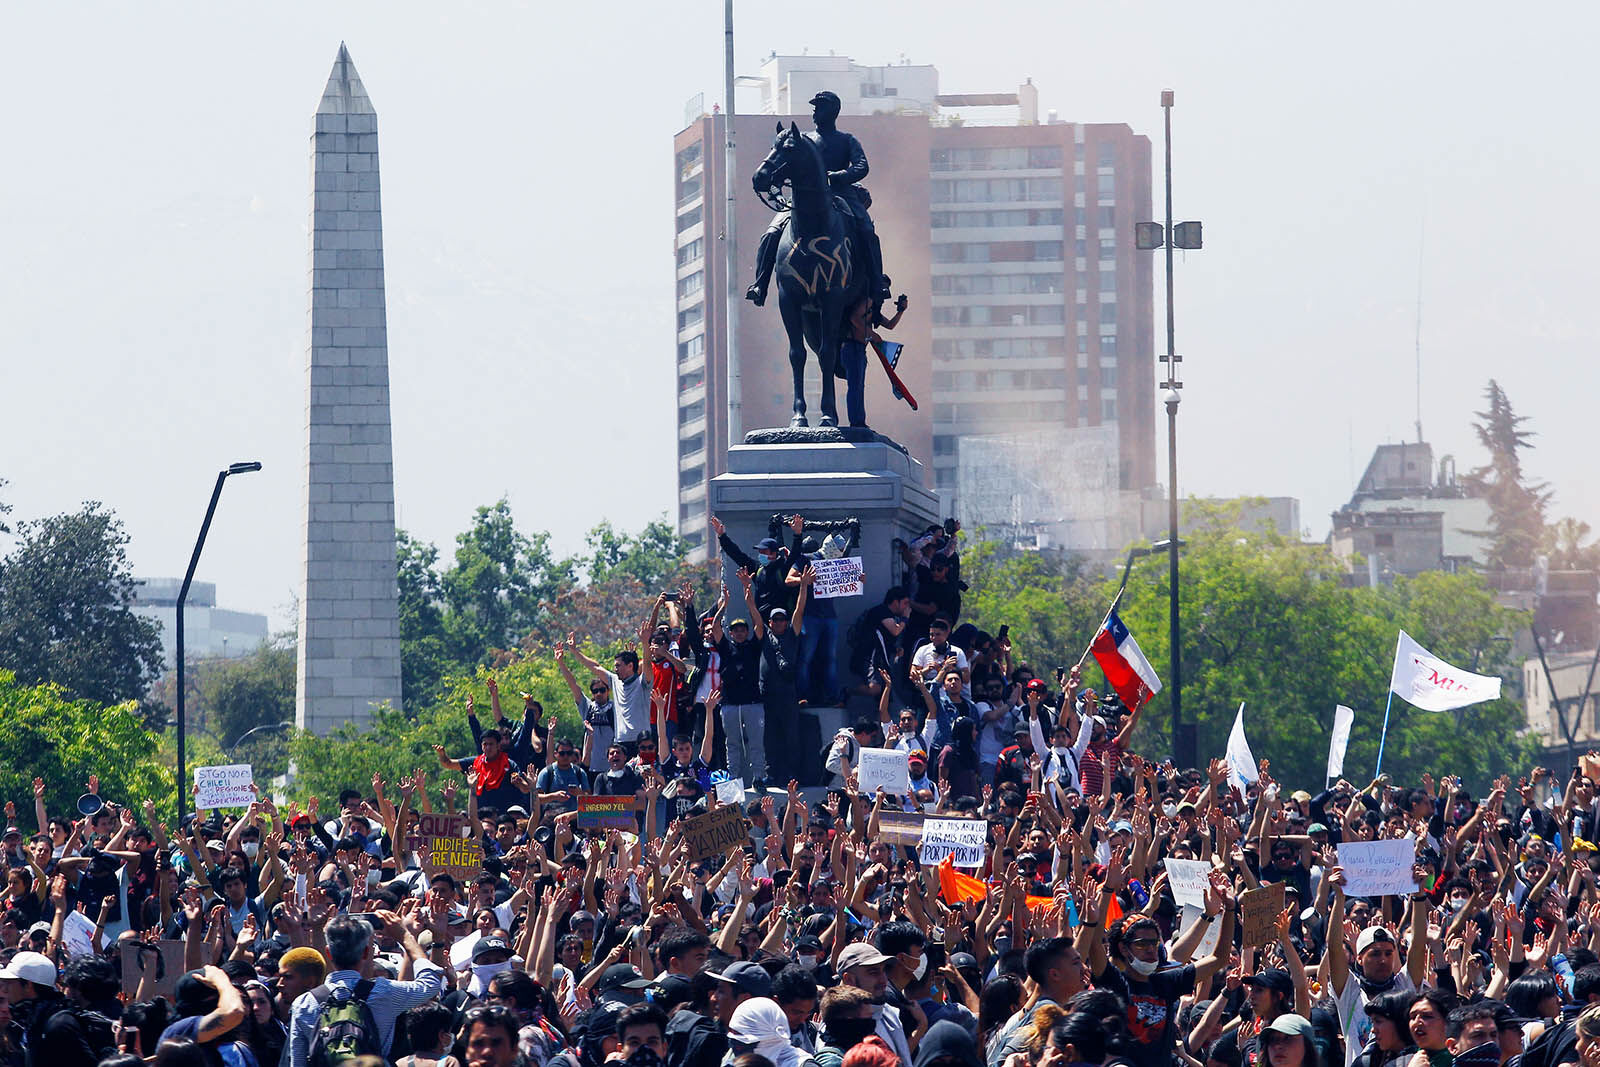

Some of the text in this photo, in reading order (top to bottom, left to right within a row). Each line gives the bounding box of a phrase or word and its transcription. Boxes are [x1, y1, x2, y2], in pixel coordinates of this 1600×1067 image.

[420, 815, 462, 838] QUE
[925, 832, 942, 843] POR
[944, 833, 957, 843] MIS
[924, 845, 940, 861] POR
